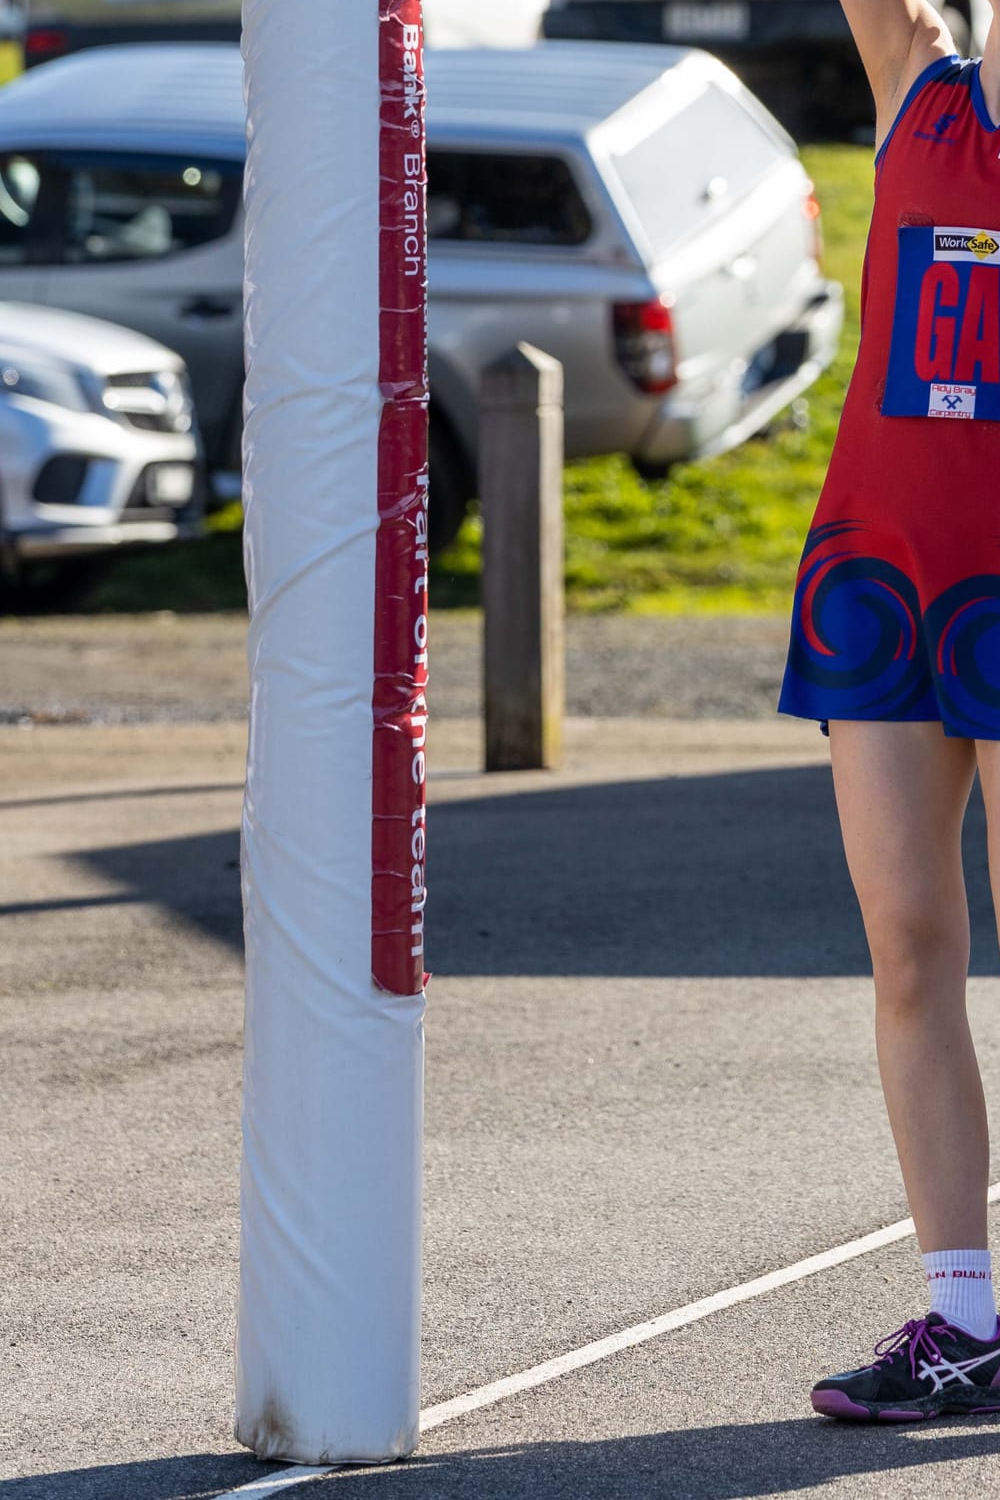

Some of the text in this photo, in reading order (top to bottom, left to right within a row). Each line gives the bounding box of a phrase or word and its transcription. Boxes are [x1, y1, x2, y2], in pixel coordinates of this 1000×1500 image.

[403, 153, 421, 276] Branch
[914, 262, 1000, 384] GA
[411, 803, 427, 957] team
[952, 1270, 986, 1279] BULN
